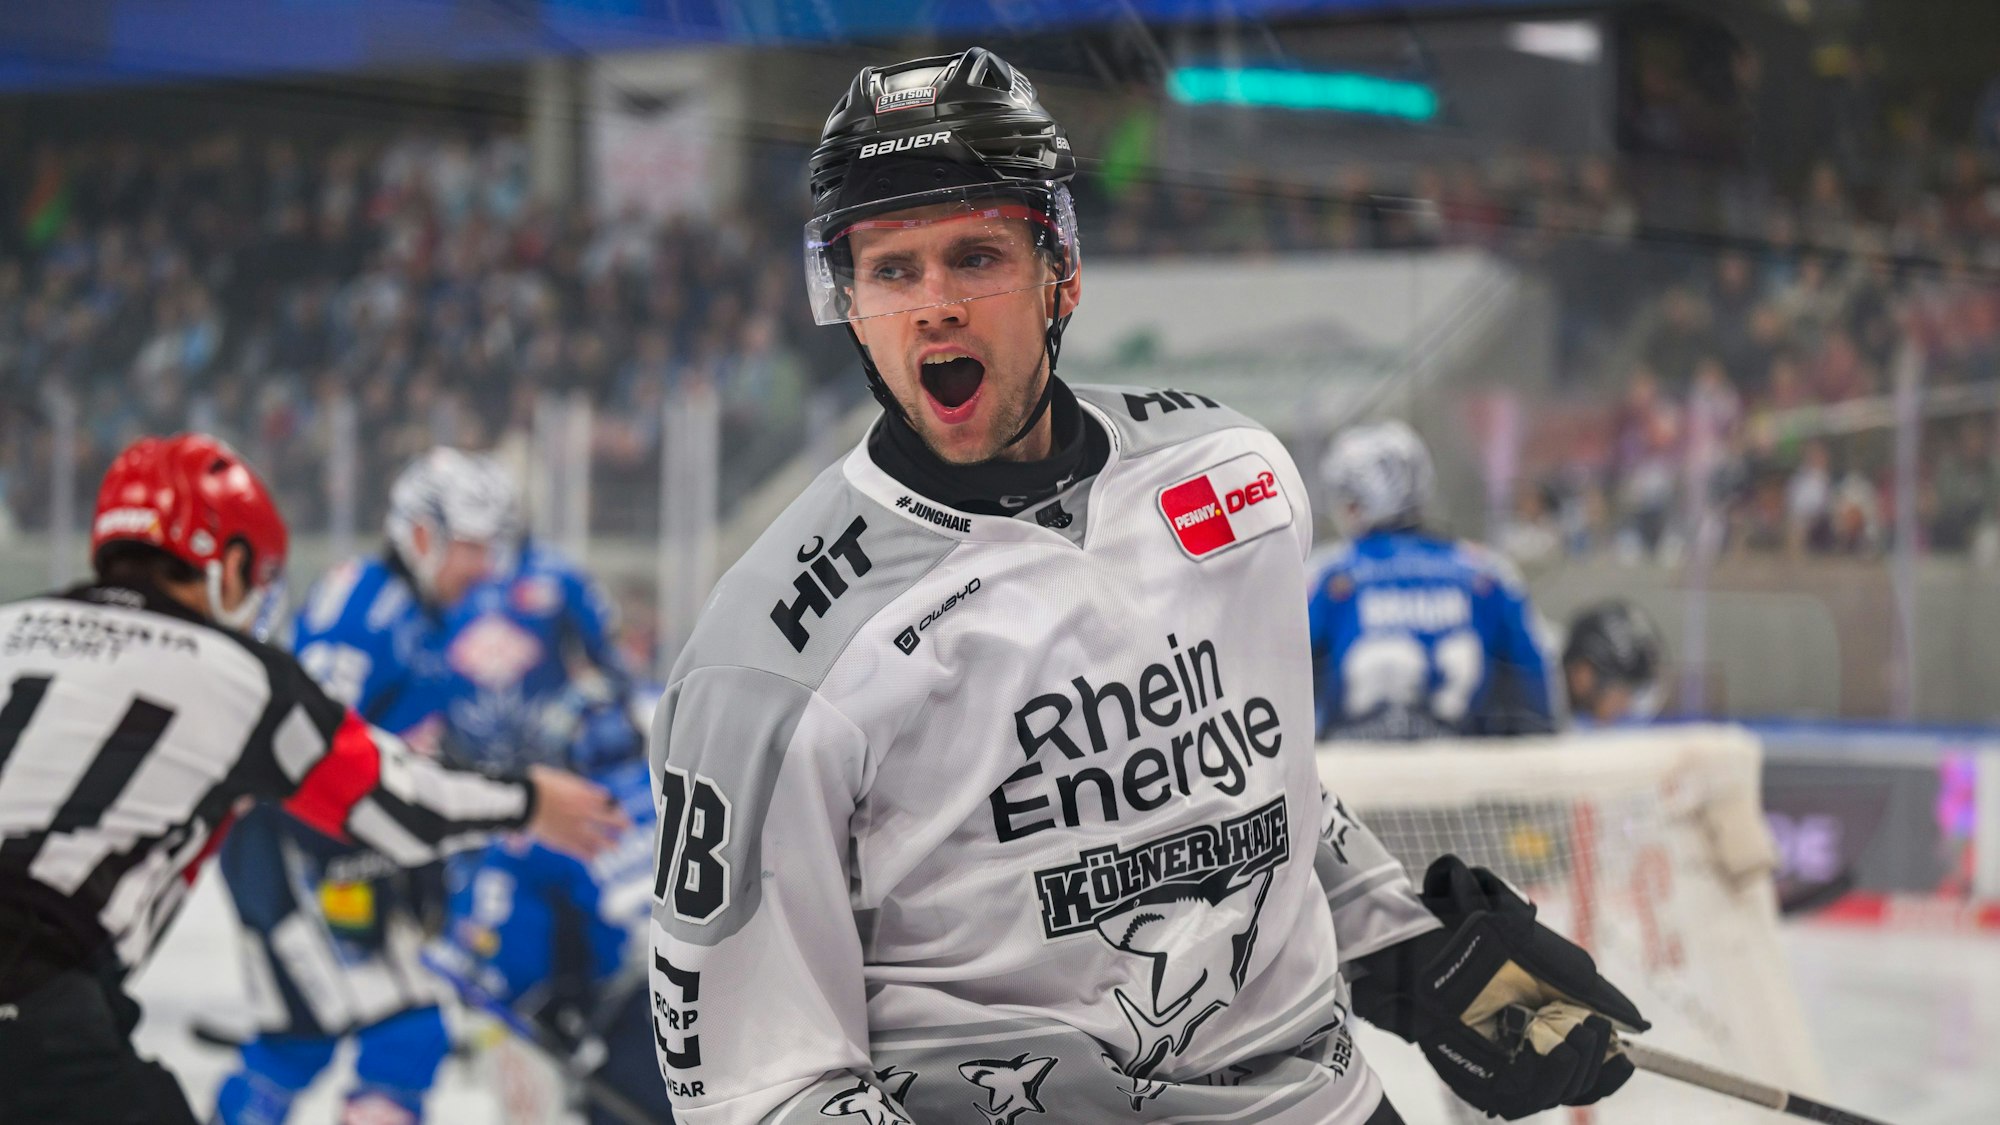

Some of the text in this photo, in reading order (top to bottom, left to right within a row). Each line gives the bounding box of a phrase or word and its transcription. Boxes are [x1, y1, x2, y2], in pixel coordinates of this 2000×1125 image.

[880, 89, 932, 105] STETSON
[895, 496, 972, 533] #JUNGHAIE
[1225, 471, 1277, 514] DEL
[770, 515, 872, 654] HIT
[1014, 633, 1224, 761] Rhein
[989, 697, 1282, 843] Energie
[1045, 832, 1217, 929] KÖLNER
